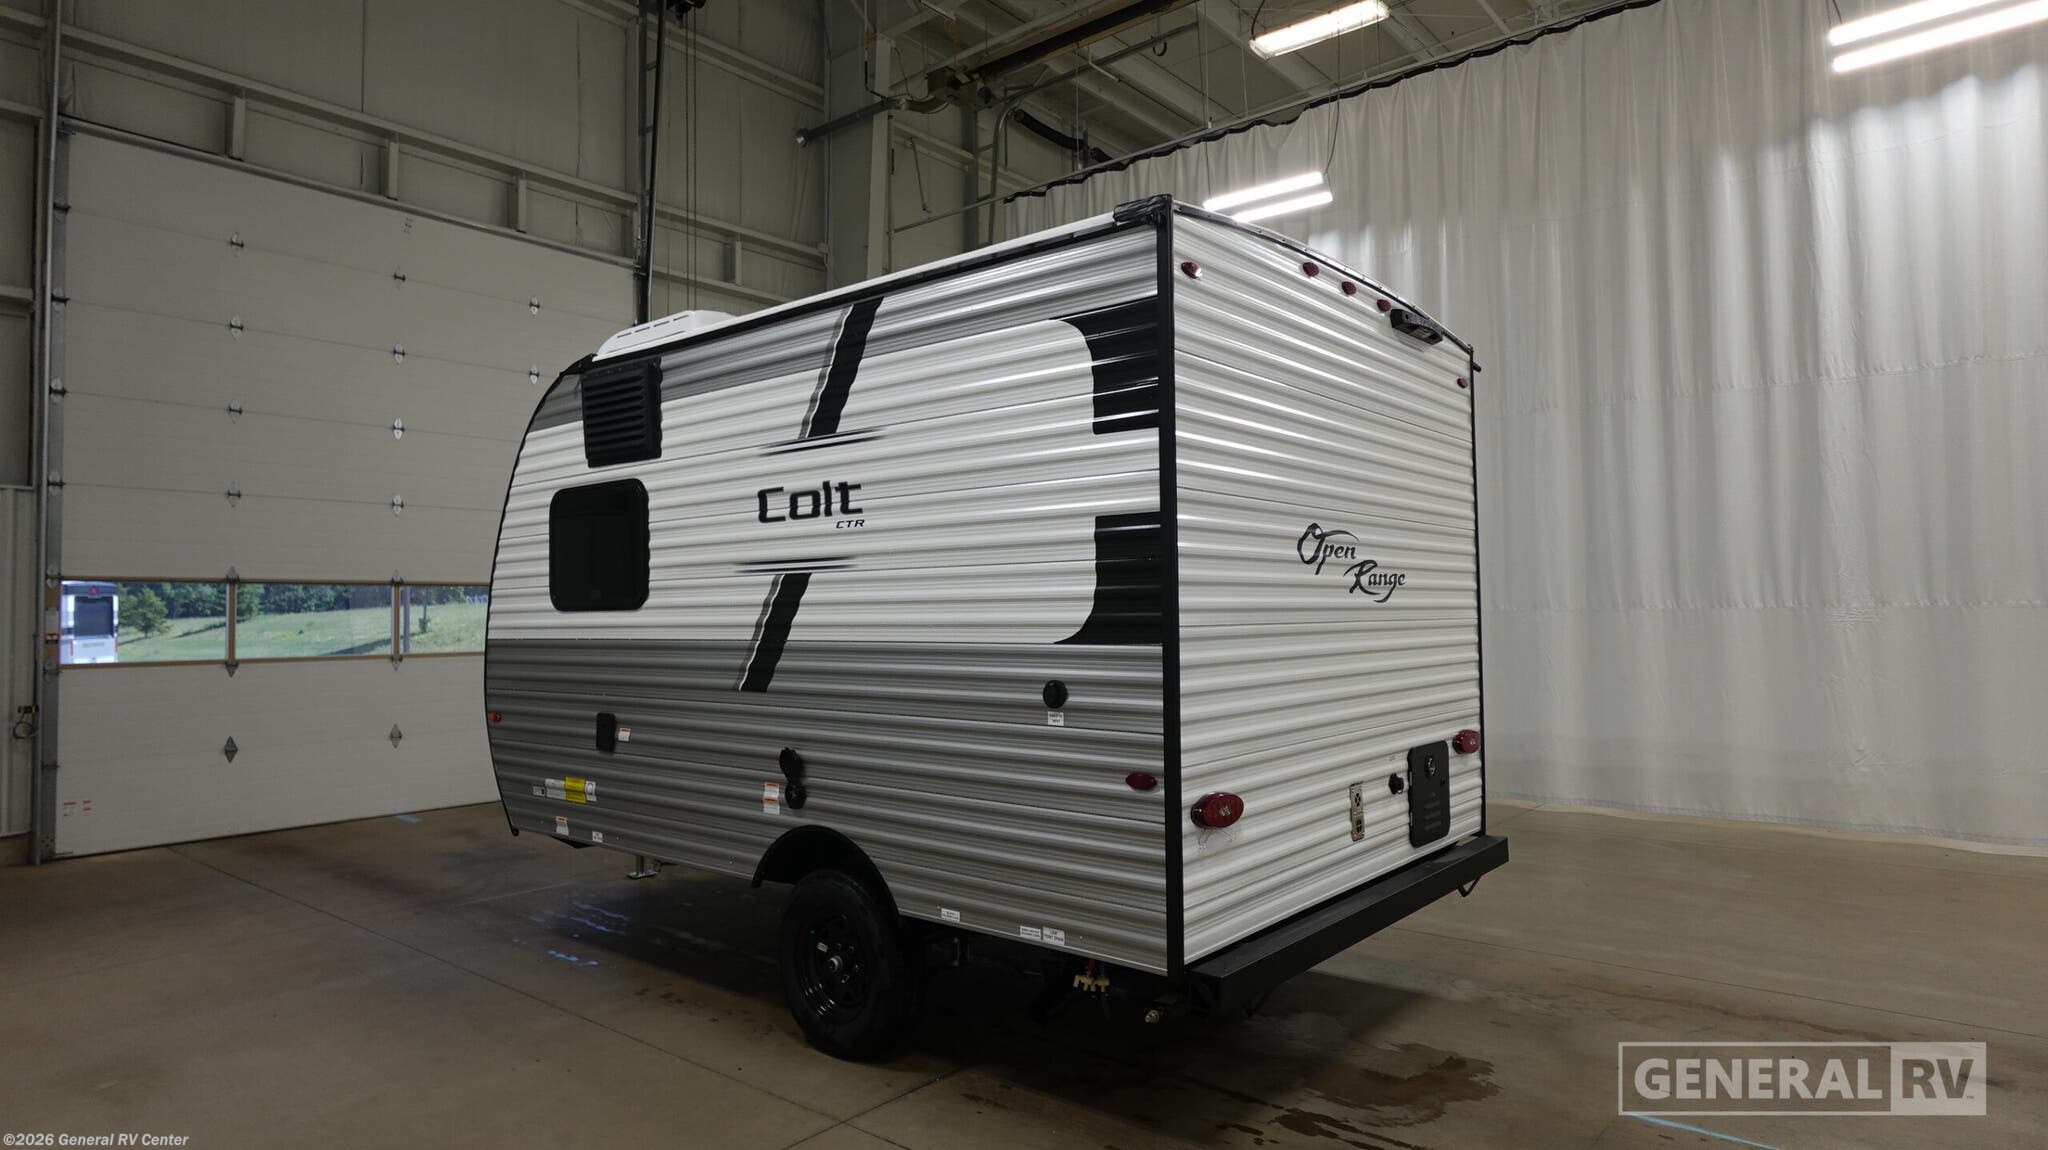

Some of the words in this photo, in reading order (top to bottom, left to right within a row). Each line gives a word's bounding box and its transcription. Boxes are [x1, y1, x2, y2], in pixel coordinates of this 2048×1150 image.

[757, 480, 863, 523] Colt
[835, 519, 865, 529] CTR
[1297, 522, 1359, 575] Open
[1343, 559, 1406, 603] Range
